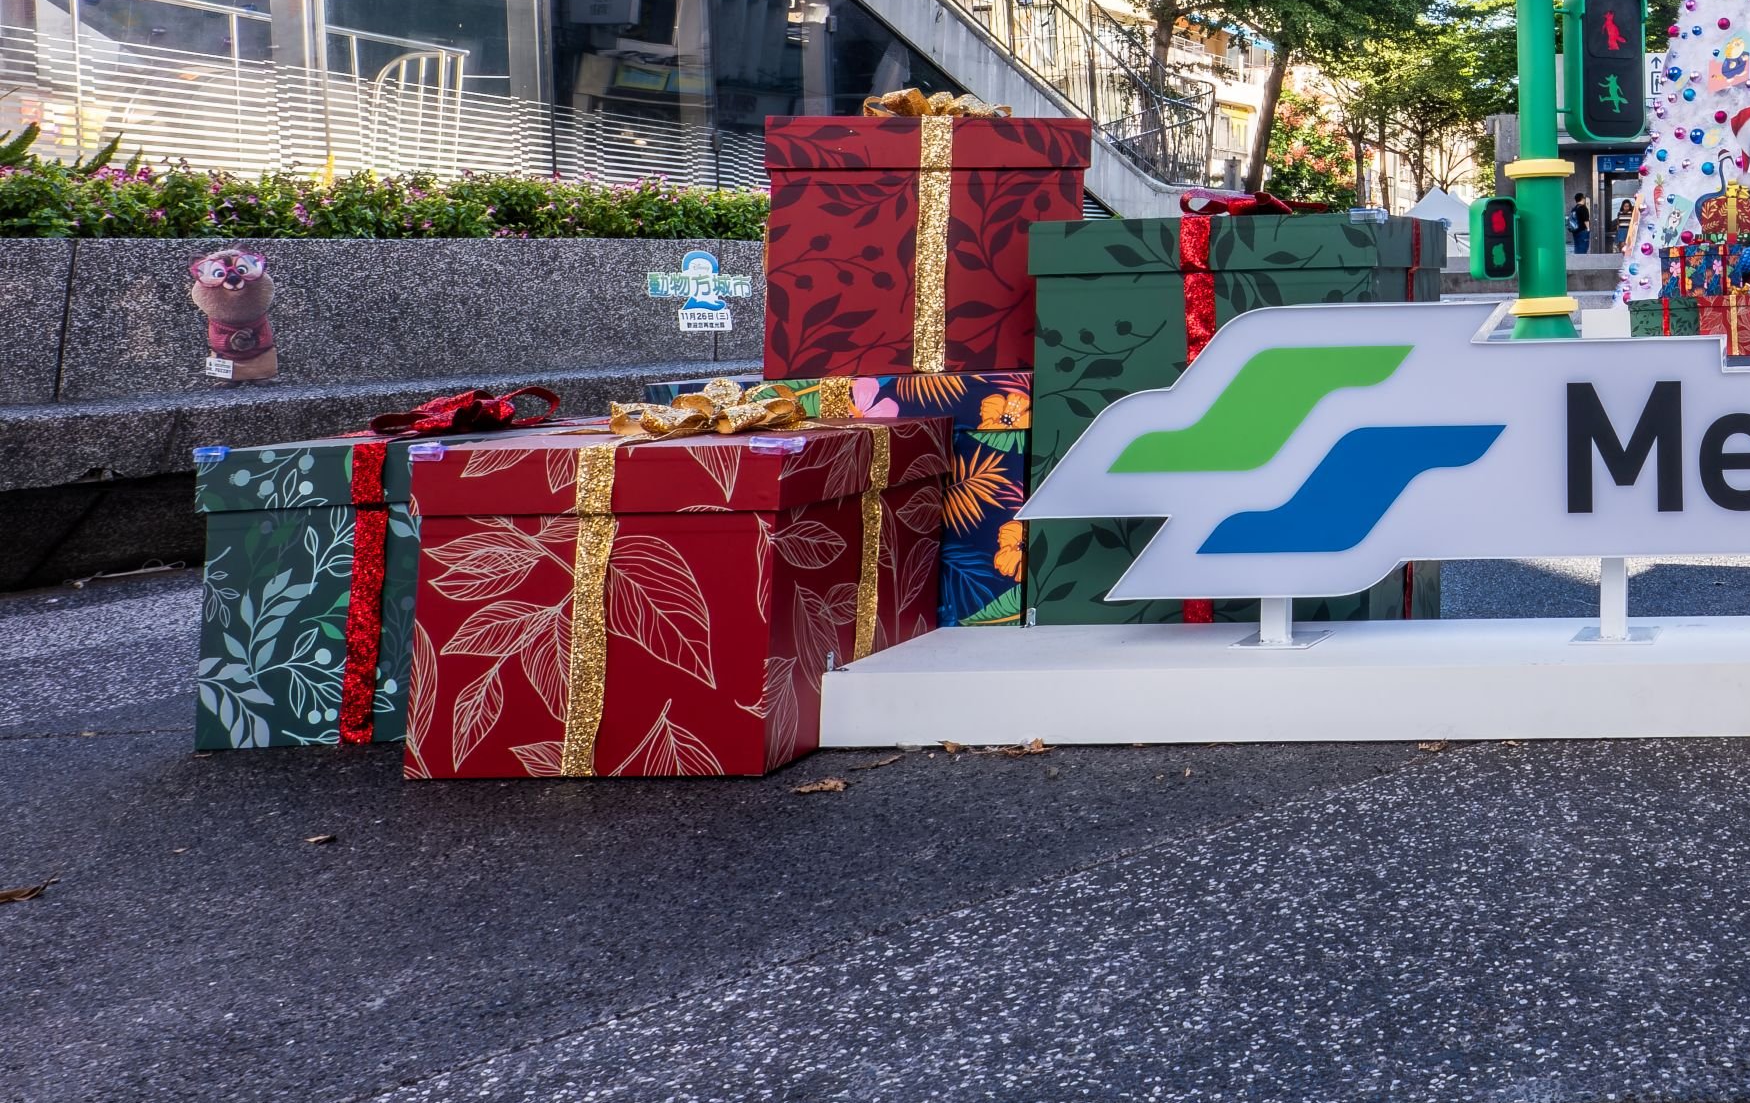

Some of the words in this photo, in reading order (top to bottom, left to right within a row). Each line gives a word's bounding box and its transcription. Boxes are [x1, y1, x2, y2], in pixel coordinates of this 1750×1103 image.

[648, 272, 752, 297] 動物方城市
